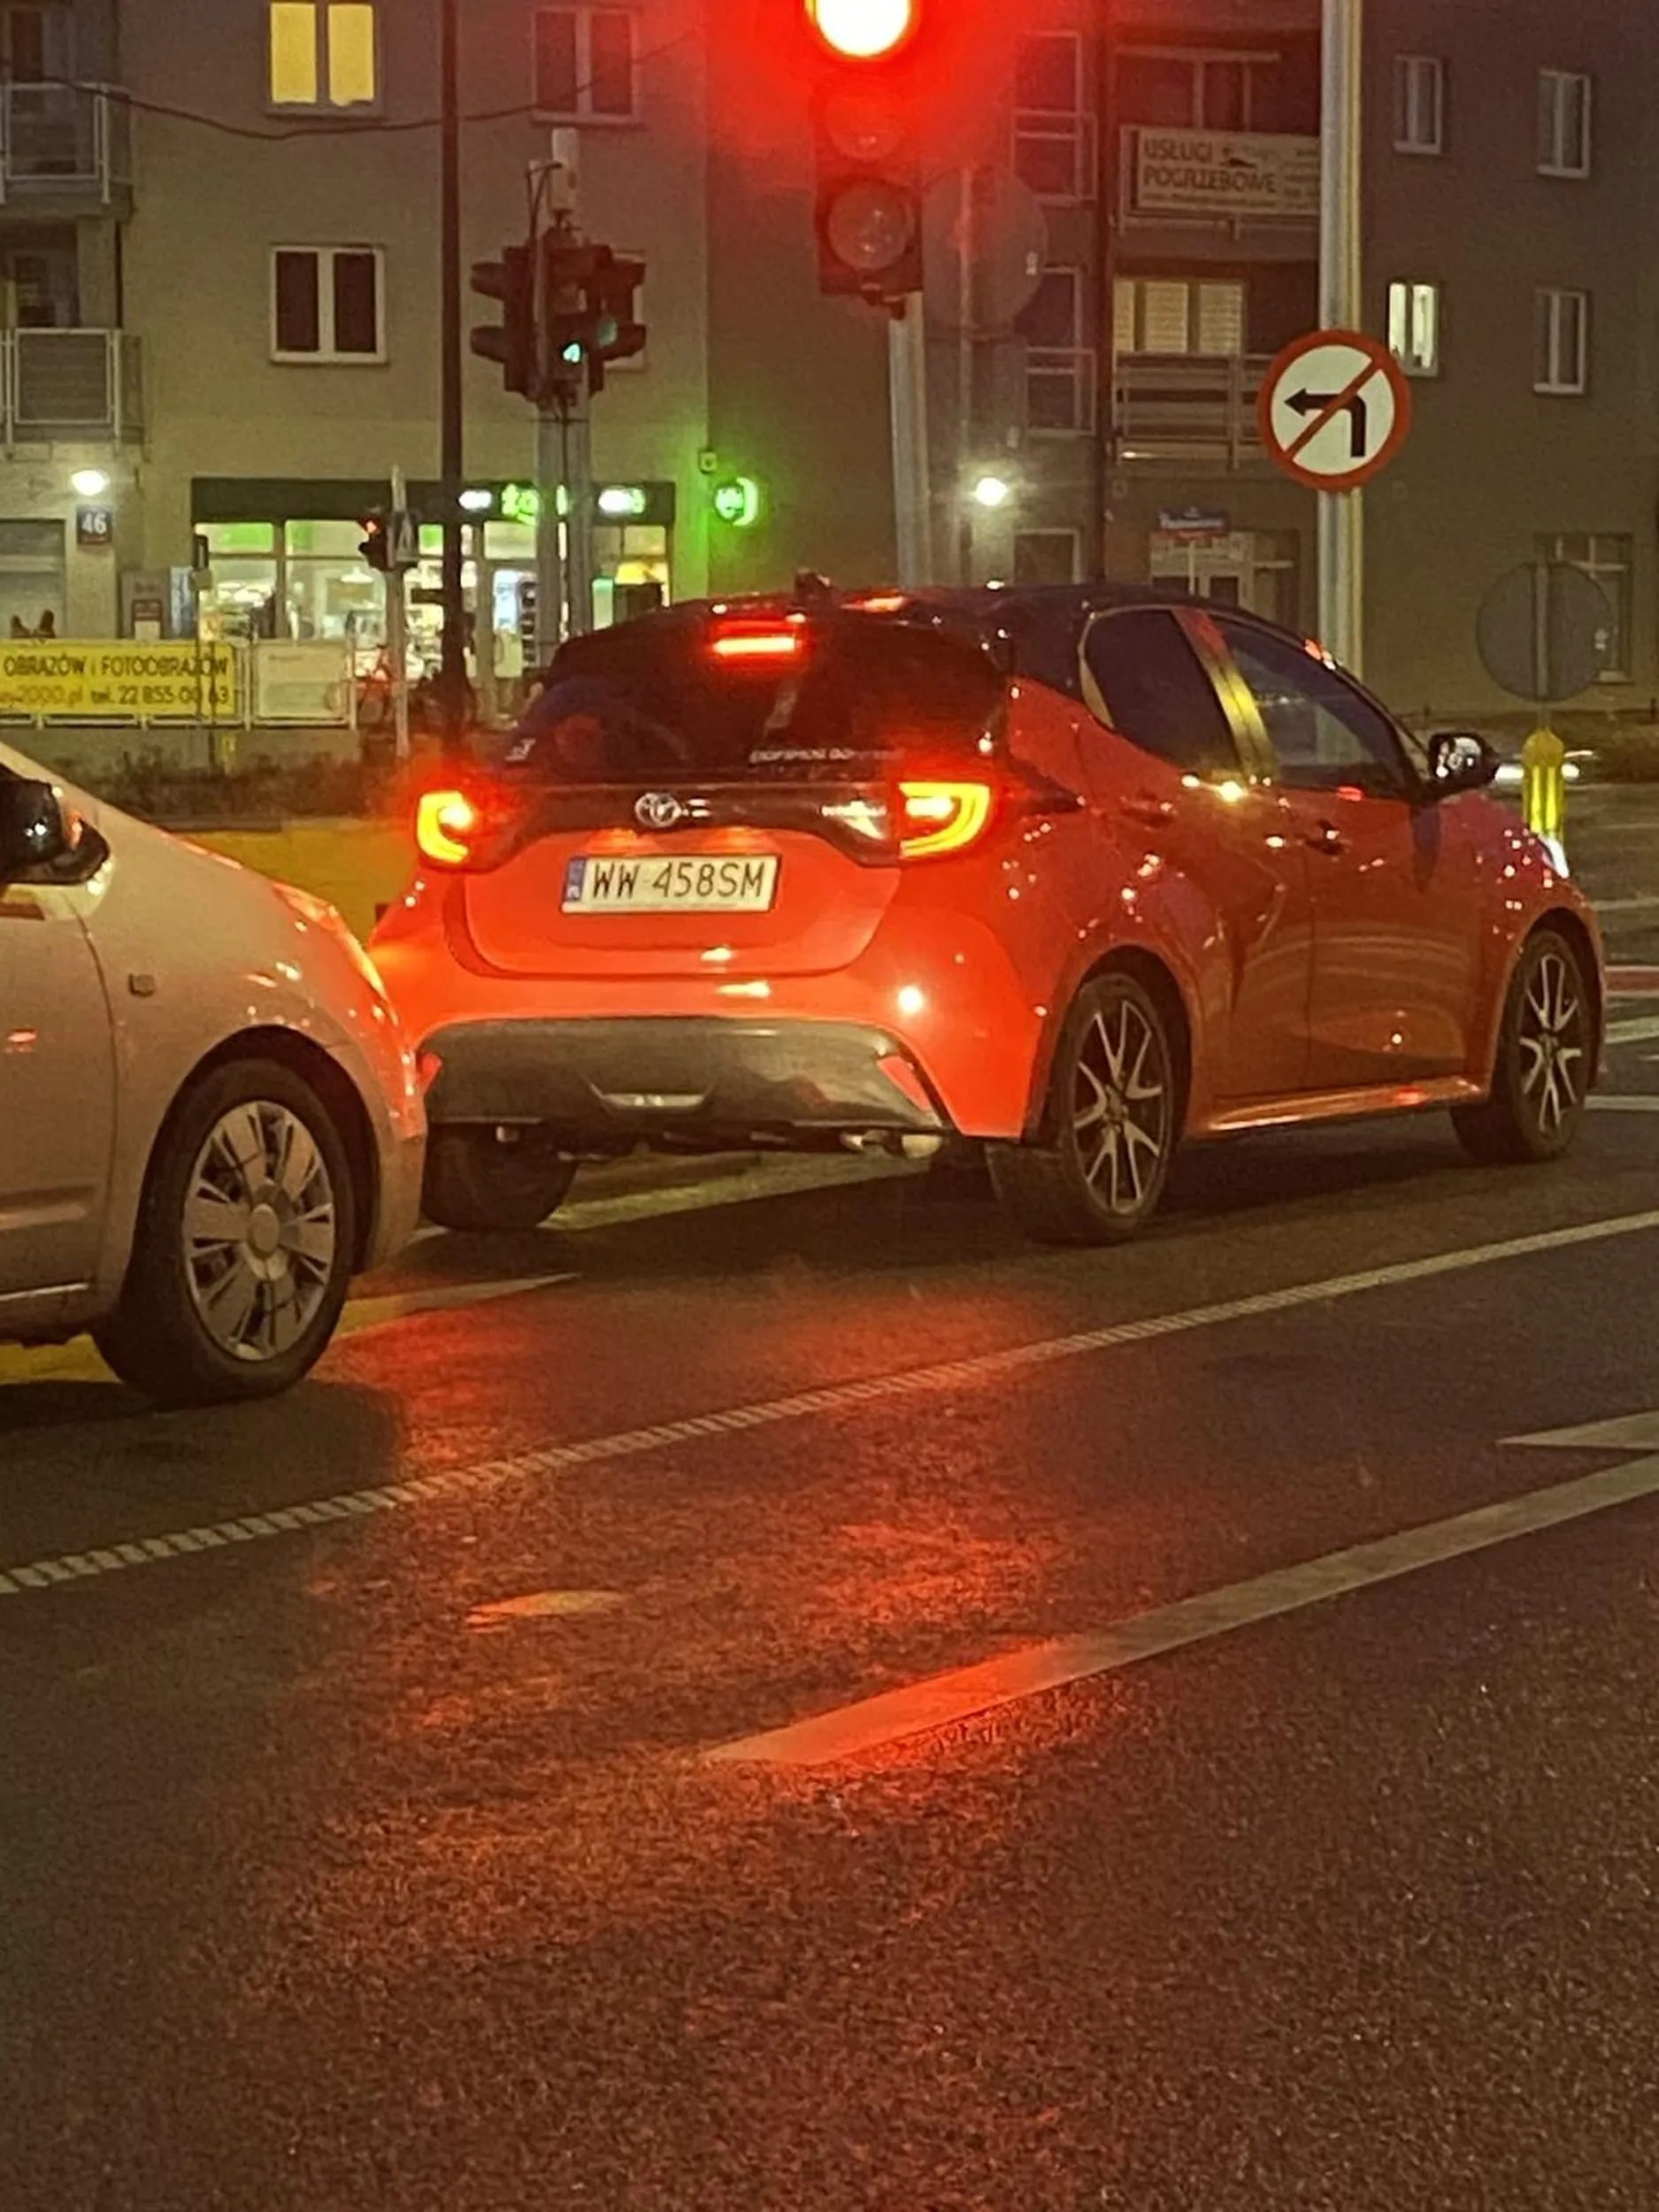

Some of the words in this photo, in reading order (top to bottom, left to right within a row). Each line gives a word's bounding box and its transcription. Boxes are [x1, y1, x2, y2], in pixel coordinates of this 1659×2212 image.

[1143, 165, 1276, 194] POGRZEBOWE
[81, 511, 107, 534] 46
[118, 686, 138, 705] 22
[592, 862, 640, 899] WW
[651, 861, 765, 898] 458SM
